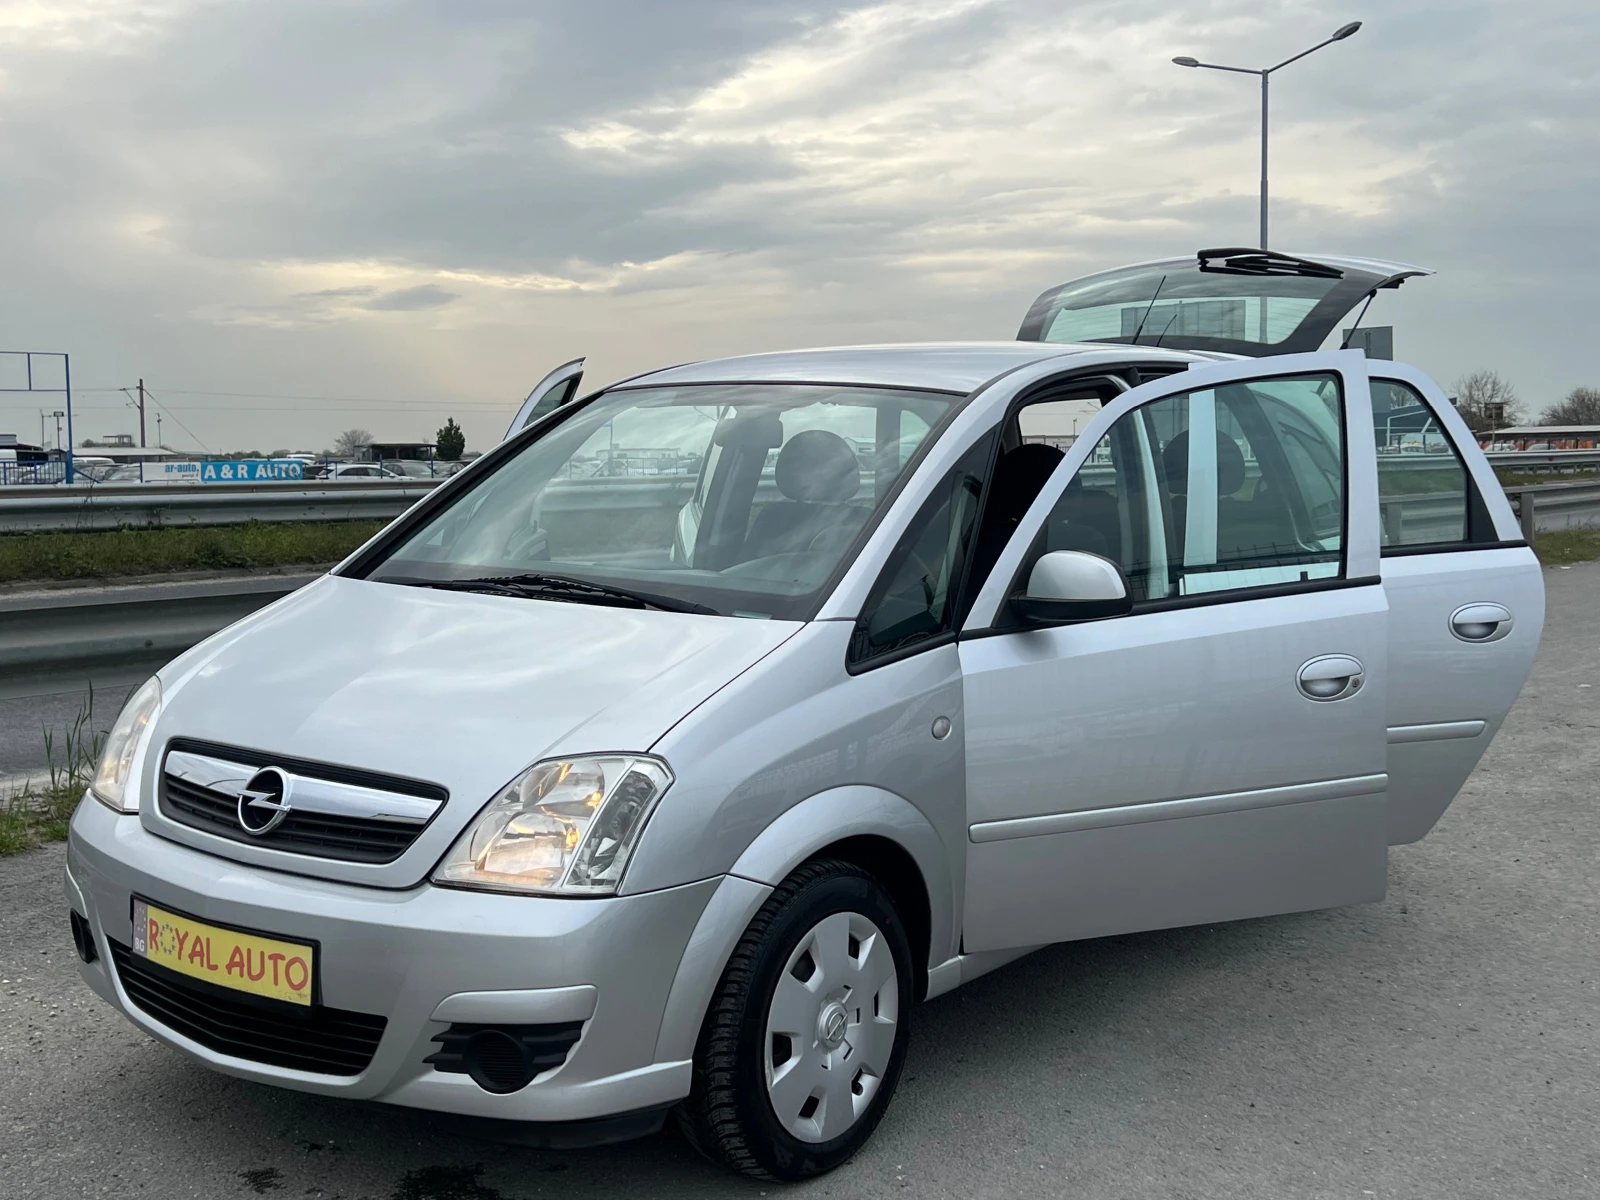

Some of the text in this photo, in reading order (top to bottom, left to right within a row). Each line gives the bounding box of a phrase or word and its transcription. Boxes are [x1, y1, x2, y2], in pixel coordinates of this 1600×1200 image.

[204, 463, 301, 479] A & R AUTO
[134, 936, 146, 953] BG
[148, 917, 309, 991] ROYAL AUTO
